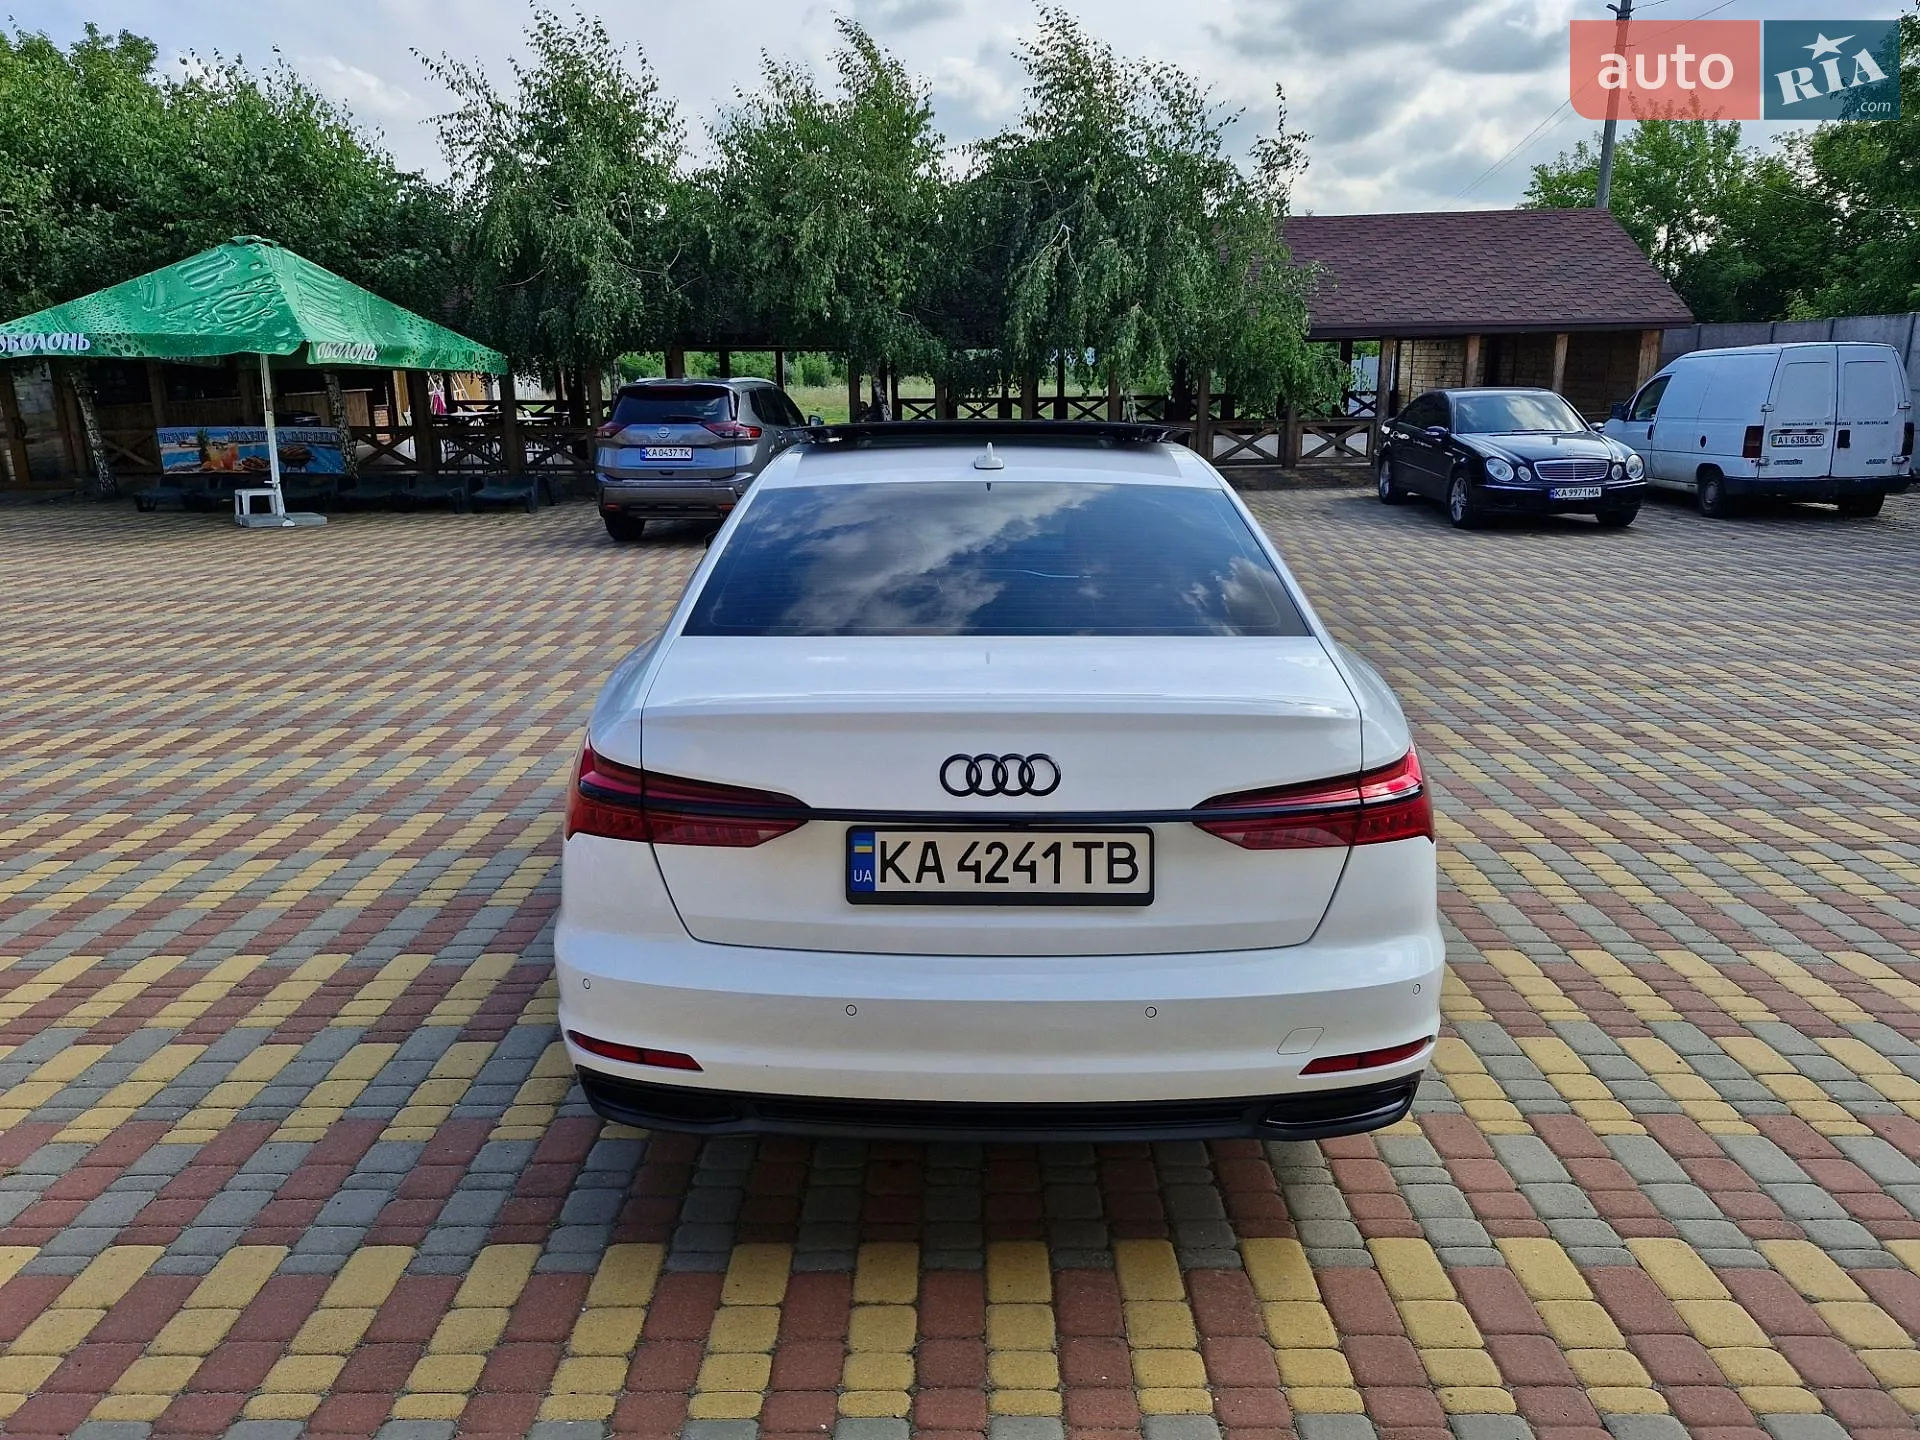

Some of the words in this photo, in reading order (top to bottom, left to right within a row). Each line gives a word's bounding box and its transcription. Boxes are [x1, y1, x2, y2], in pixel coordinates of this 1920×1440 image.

[317, 342, 377, 361] ОБОЛОНЬ
[1790, 436, 1809, 444] 6385
[659, 449, 678, 457] 0437
[1568, 488, 1587, 497] 9971
[879, 840, 946, 884] KA
[957, 841, 1062, 884] 4241
[1072, 841, 1139, 884] TB
[853, 869, 873, 883] UA
